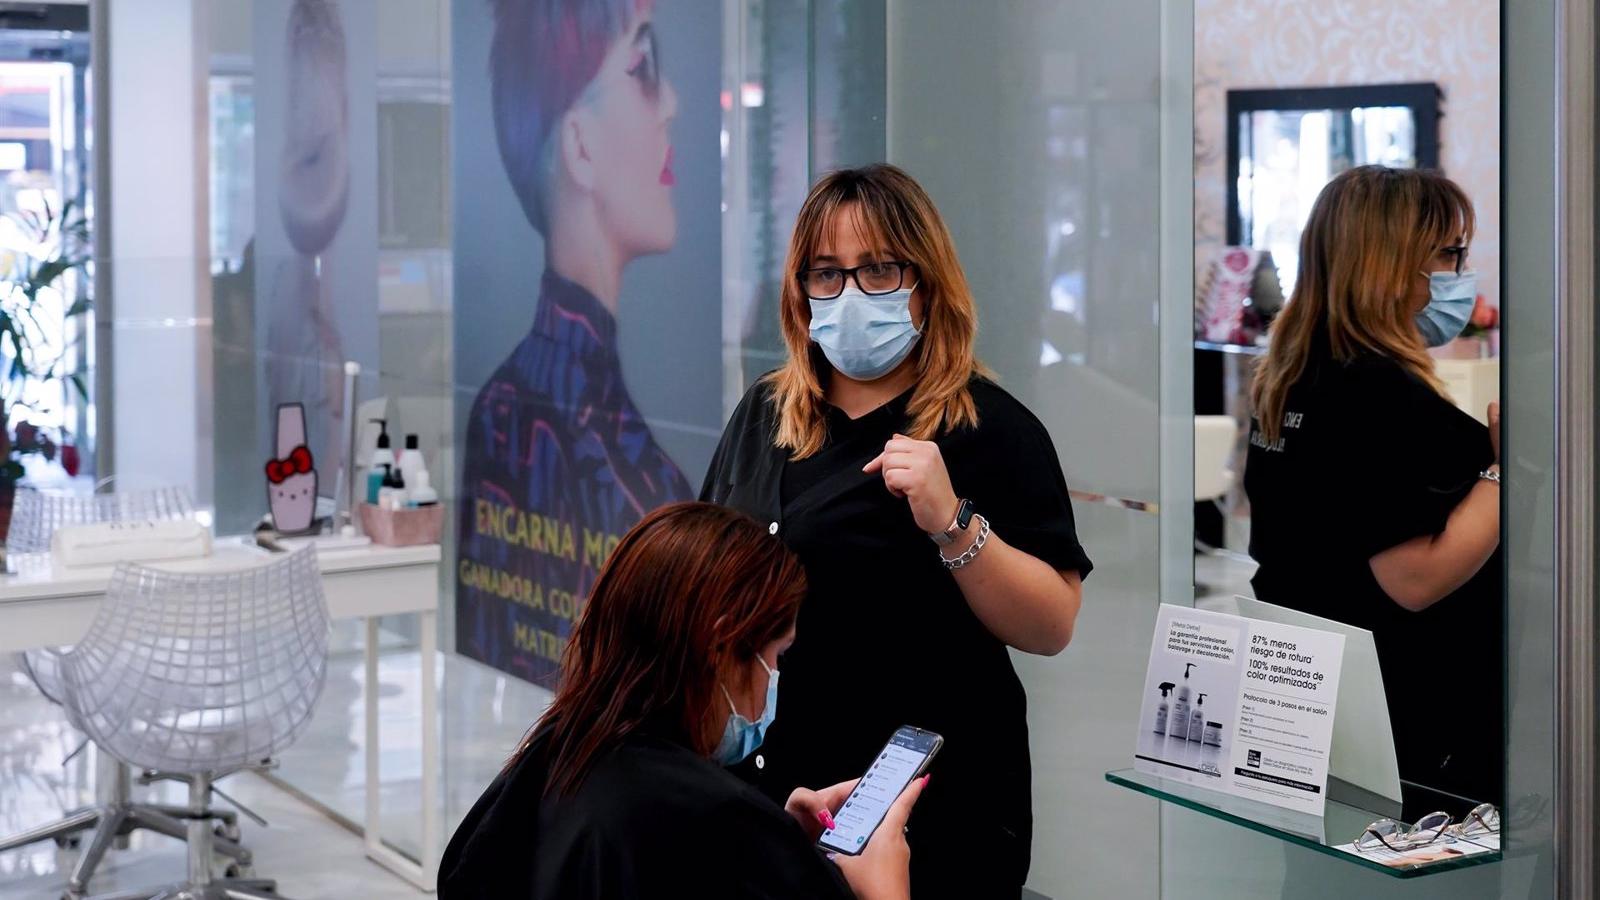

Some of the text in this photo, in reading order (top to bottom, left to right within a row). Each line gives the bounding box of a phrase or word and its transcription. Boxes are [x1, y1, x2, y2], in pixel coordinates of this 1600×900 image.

[476, 499, 576, 561] ENCARNA
[460, 560, 544, 609] GANADORA
[1190, 641, 1212, 650] servicios
[1252, 635, 1297, 651] 87% menos
[1250, 646, 1274, 658] riesgo
[1276, 651, 1287, 660] de
[1246, 670, 1267, 680] color
[1249, 659, 1324, 681] 100% resultados de
[1243, 693, 1268, 704] Protocolo
[1281, 702, 1297, 710] pasos
